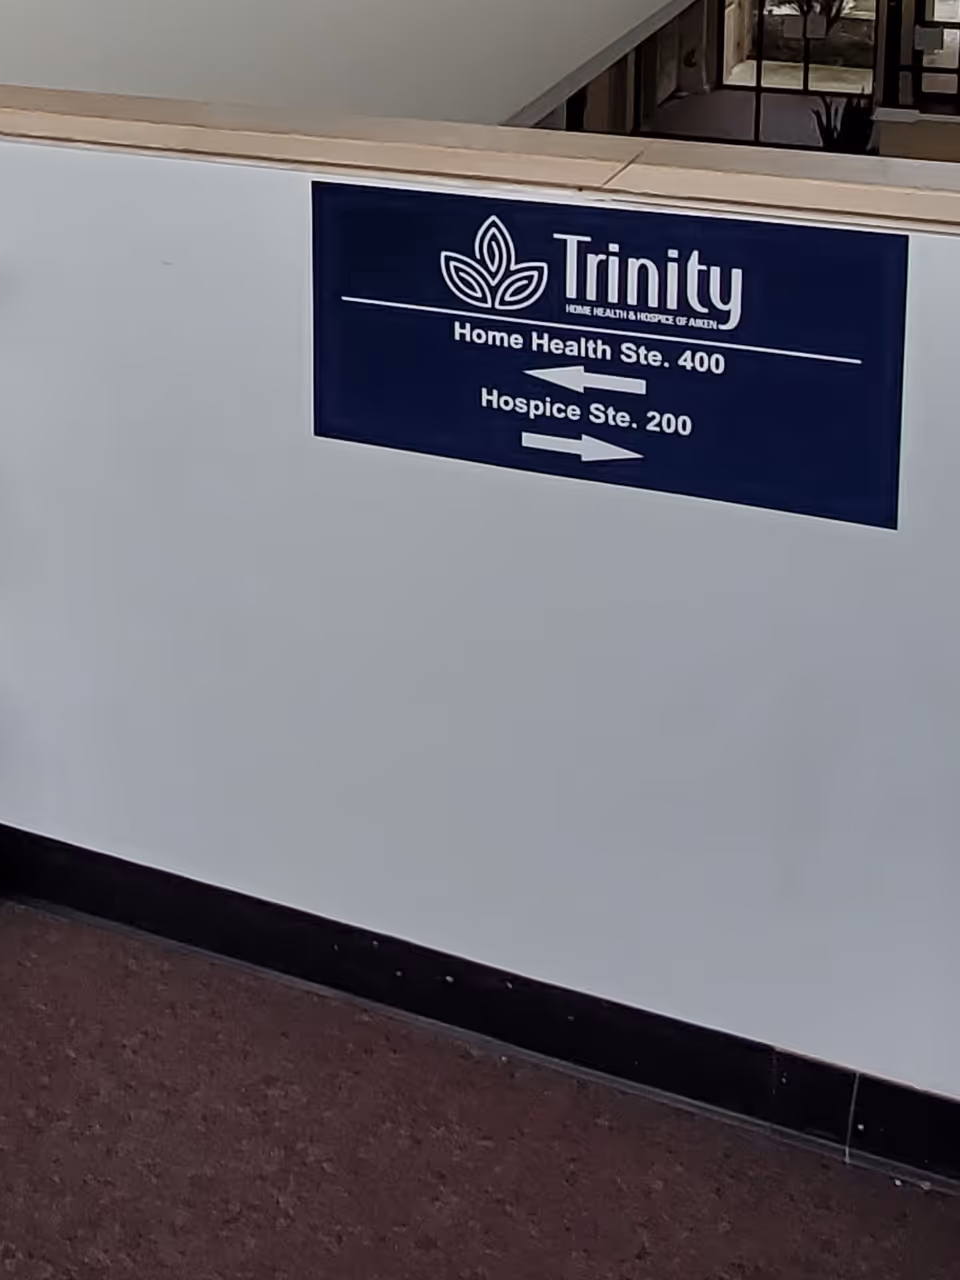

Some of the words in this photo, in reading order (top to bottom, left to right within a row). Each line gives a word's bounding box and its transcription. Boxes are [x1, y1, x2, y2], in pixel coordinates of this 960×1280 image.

[552, 233, 743, 331] Trinity
[565, 303, 592, 316] HOME
[593, 307, 627, 320] HEALTH
[627, 310, 636, 321] &
[636, 312, 675, 326] HOSPICE
[675, 316, 688, 327] OF
[454, 321, 524, 350] Home
[531, 331, 613, 361] Health
[620, 342, 670, 367] Ste.
[677, 350, 726, 375] 400
[481, 387, 581, 421] Hospice
[588, 402, 638, 429] Ste.
[645, 410, 692, 436] 200
